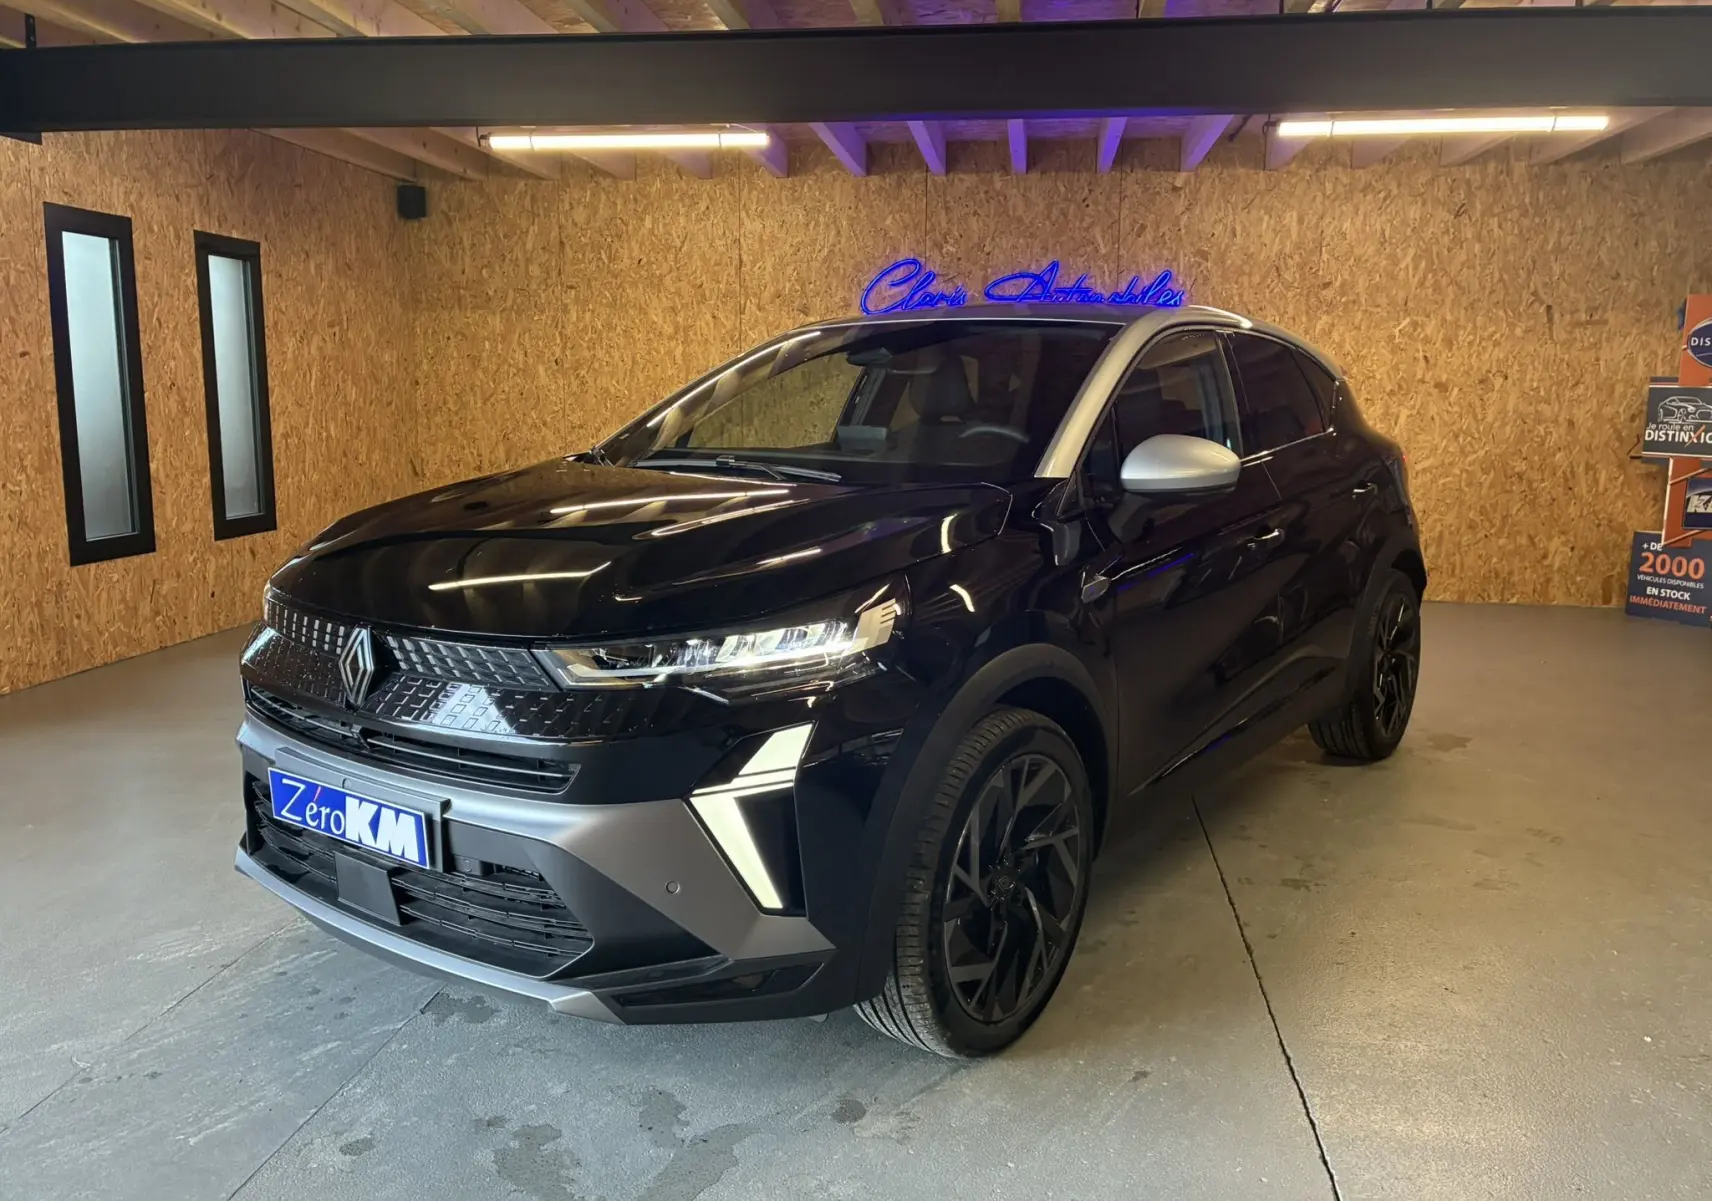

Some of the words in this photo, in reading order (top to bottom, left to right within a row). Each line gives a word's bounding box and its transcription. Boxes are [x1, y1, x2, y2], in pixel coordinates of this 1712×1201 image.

[984, 259, 1184, 307] Automobiles
[1647, 422, 1657, 430] Je
[1659, 422, 1681, 431] roule
[1642, 542, 1649, 550] +
[1650, 541, 1663, 551] DE
[1639, 551, 1705, 580] 2000
[1667, 578, 1705, 590] DISPONIBLES
[1646, 586, 1659, 596] EN
[1660, 588, 1691, 601] STOCK
[1629, 595, 1707, 614] IMMÉDIATEMENT
